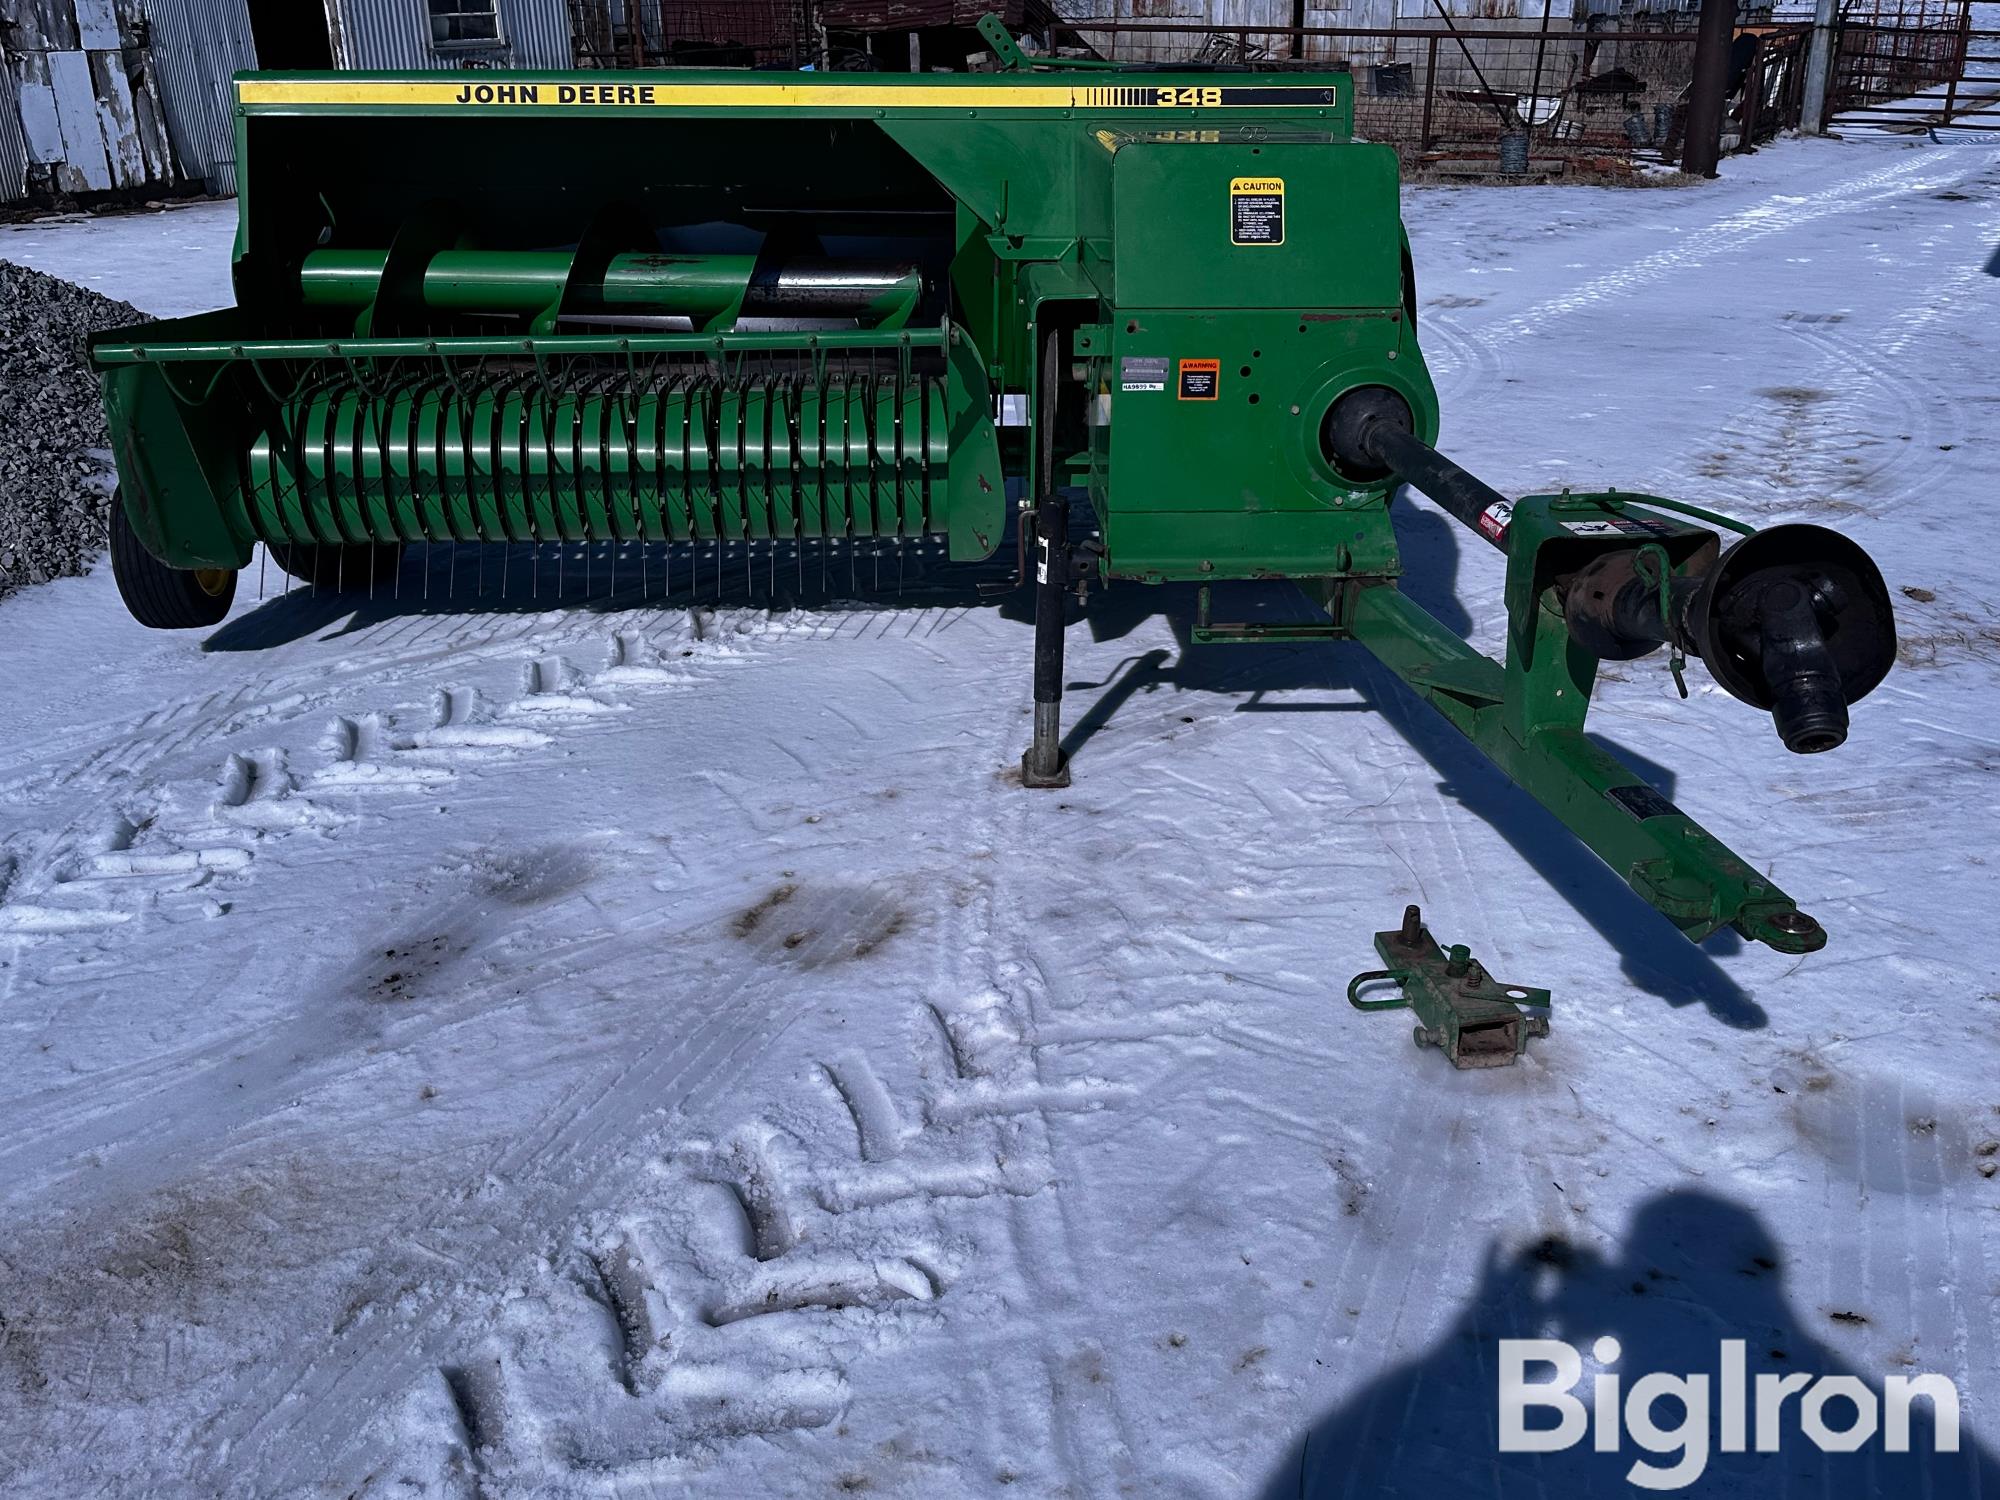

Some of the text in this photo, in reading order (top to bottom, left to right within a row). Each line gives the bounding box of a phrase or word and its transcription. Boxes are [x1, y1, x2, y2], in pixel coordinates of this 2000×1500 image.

[456, 85, 656, 105] JOHN DEERE
[1156, 87, 1222, 107] 348
[1243, 182, 1281, 191] CAUTION
